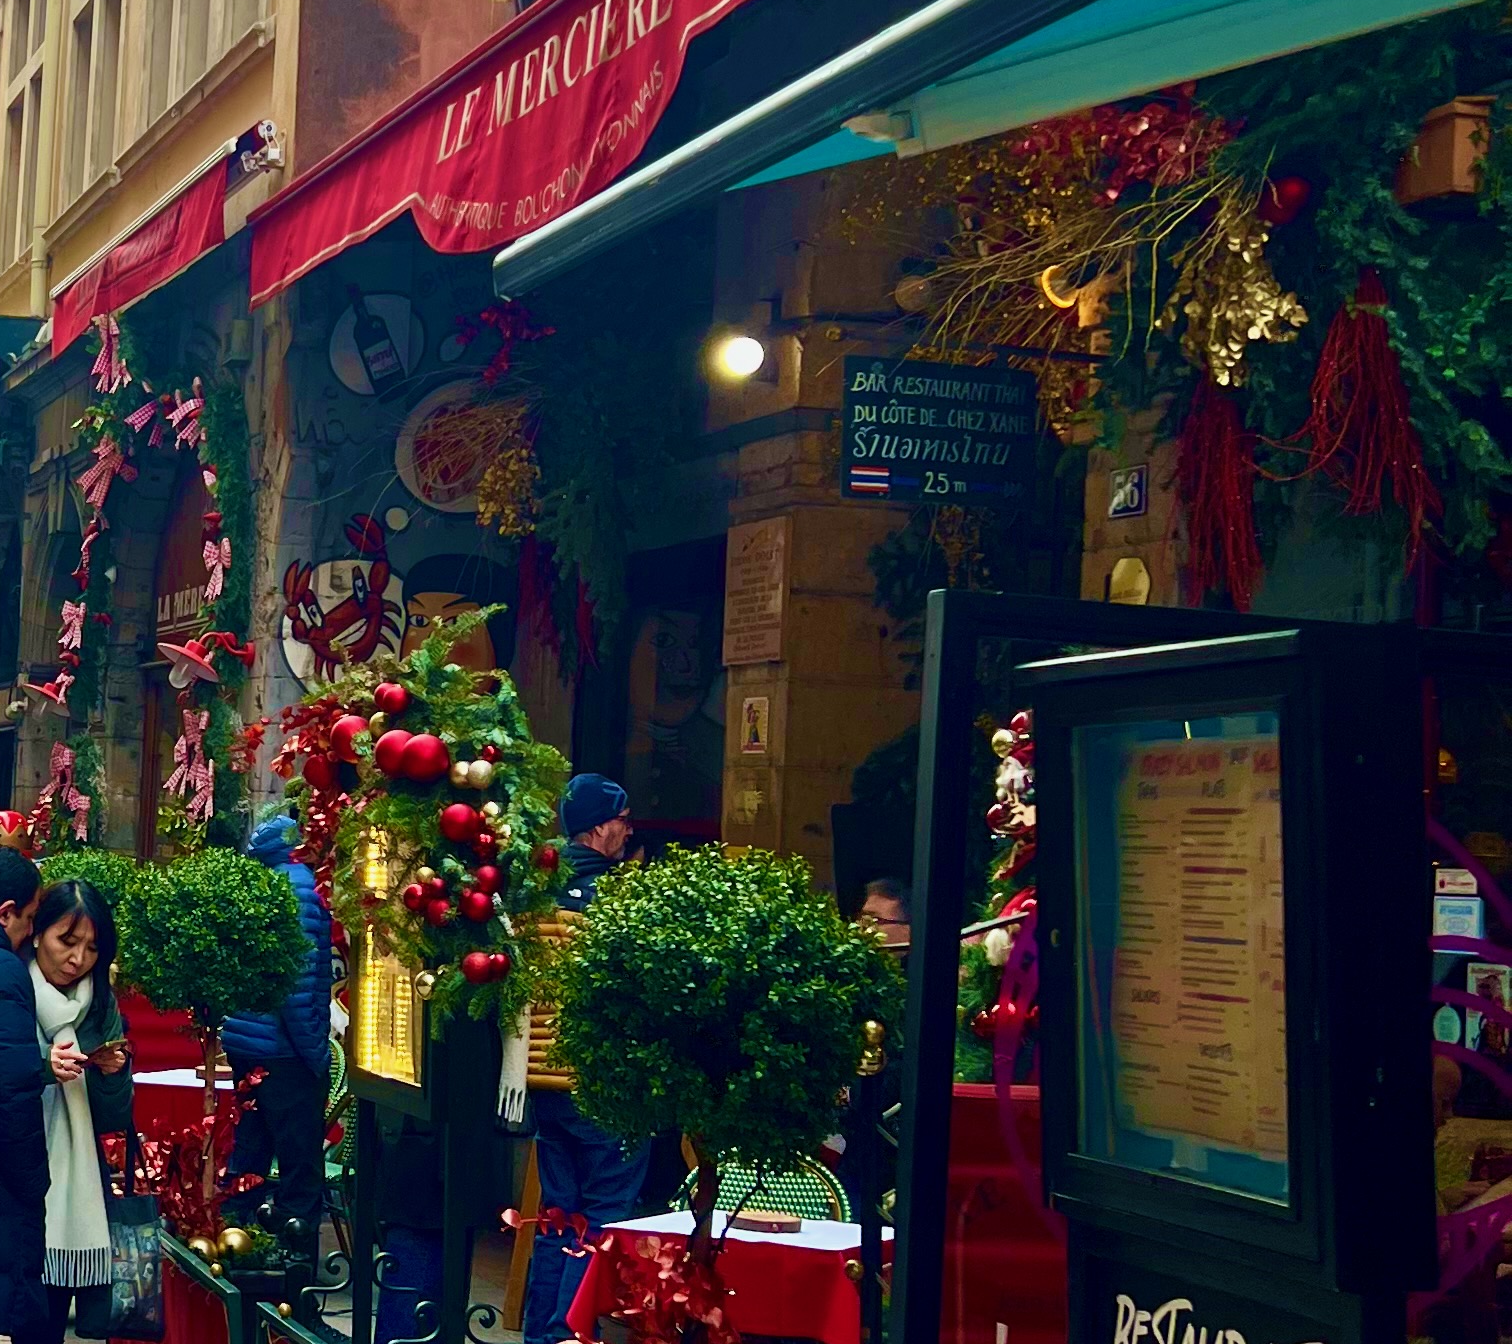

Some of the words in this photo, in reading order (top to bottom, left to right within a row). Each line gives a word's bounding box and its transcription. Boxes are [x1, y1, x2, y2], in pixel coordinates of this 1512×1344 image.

[435, 86, 482, 165] LE
[513, 160, 586, 228] BOUCHON
[850, 371, 889, 394] BAR
[891, 375, 994, 402] RESTAURANT
[852, 405, 877, 424] DU
[947, 409, 986, 432] CHEZ
[923, 471, 950, 495] 25
[954, 479, 968, 494] m
[157, 594, 171, 623] LA
